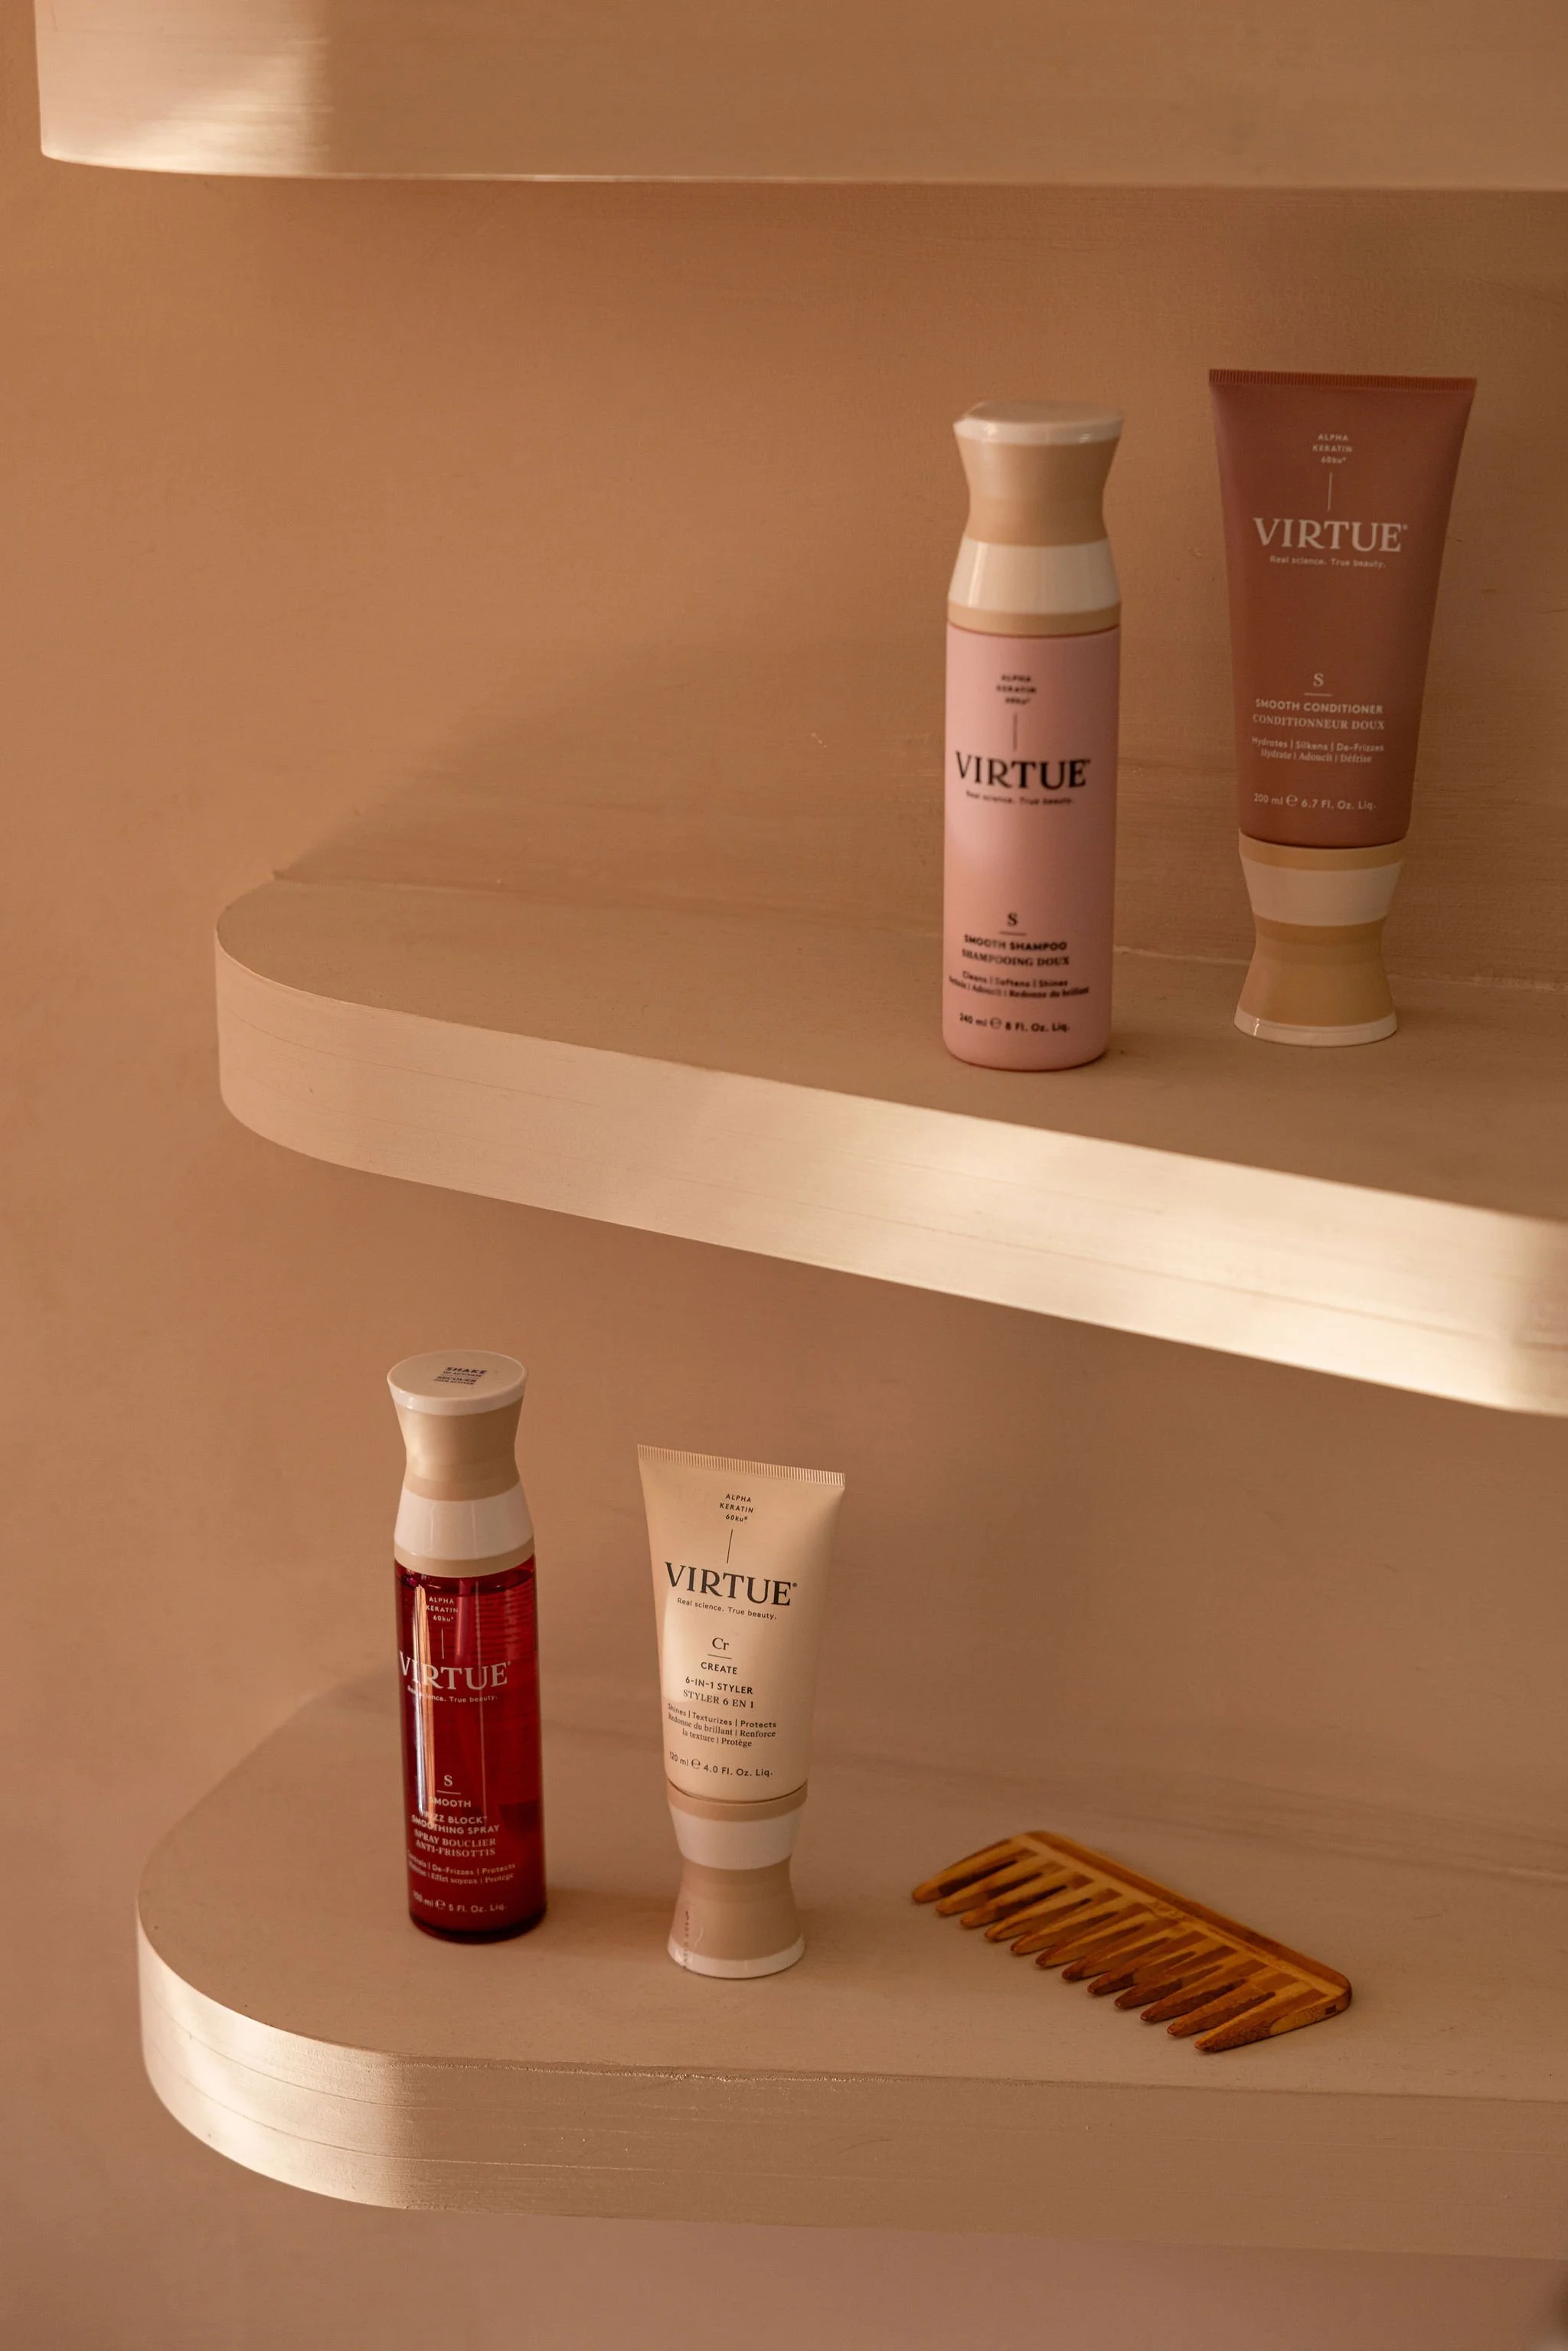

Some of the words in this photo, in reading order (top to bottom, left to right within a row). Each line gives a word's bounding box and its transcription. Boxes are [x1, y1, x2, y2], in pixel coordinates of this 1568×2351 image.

[1318, 433, 1349, 442] ALPHA
[1270, 555, 1289, 564] Real
[1331, 558, 1350, 567] True
[1313, 673, 1325, 687] S
[1255, 698, 1300, 711] SMOOTH
[1303, 702, 1383, 715] CONDITIONER
[1253, 713, 1348, 730] CONDITIONNEUR
[1351, 720, 1385, 731] DOUX
[1252, 736, 1288, 749] Hydrates
[1295, 740, 1328, 751] Silkens
[1337, 742, 1384, 753] De-Frizzes
[1253, 793, 1269, 804] 200
[1271, 796, 1283, 806] ml
[1302, 798, 1318, 808] 6.7
[1321, 799, 1334, 809] Fl.
[1338, 801, 1355, 811] Oz.
[1007, 912, 1018, 927] S
[964, 933, 1007, 950] SMOOTH
[1009, 941, 1068, 951] SHAMPOO
[962, 949, 1034, 967] SHAMPOOING
[1037, 955, 1070, 966] DOUX
[725, 1494, 752, 1503] ALPHA
[719, 1503, 754, 1513] KERATIN
[426, 1605, 459, 1613] KERATIN
[429, 1596, 454, 1605] ALPHA
[677, 1597, 692, 1607] Real
[694, 1601, 725, 1612] science.
[727, 1606, 745, 1615] True
[747, 1609, 778, 1621] beauty.
[711, 1637, 730, 1651] Cr
[701, 1661, 738, 1675] CREATE
[685, 1676, 714, 1690] 6-IN-1
[717, 1683, 753, 1695] STYLER
[683, 1689, 720, 1705] STYLER
[732, 1699, 747, 1709] EN
[668, 1703, 687, 1717] Shines
[692, 1712, 733, 1726] Texturizes
[740, 1719, 777, 1729] Protects
[668, 1712, 692, 1729] Redonne
[694, 1721, 703, 1731] du
[704, 1723, 733, 1736] brillant
[740, 1729, 776, 1739] Renforce
[690, 1731, 715, 1743] texture
[721, 1737, 753, 1749] Protège
[680, 1757, 689, 1767] ml
[703, 1764, 718, 1774] 4.0
[721, 1766, 733, 1776] Fl.
[736, 1768, 753, 1777] Oz.
[756, 1768, 774, 1778] Liq.
[443, 1775, 453, 1788] S
[411, 1814, 465, 1835] SMOOTHING
[468, 1824, 500, 1835] SPRAY
[414, 1829, 439, 1845] SPRAY
[442, 1837, 496, 1848] BOUCLIER
[416, 1839, 496, 1858] ANTI-FRISOTTIS
